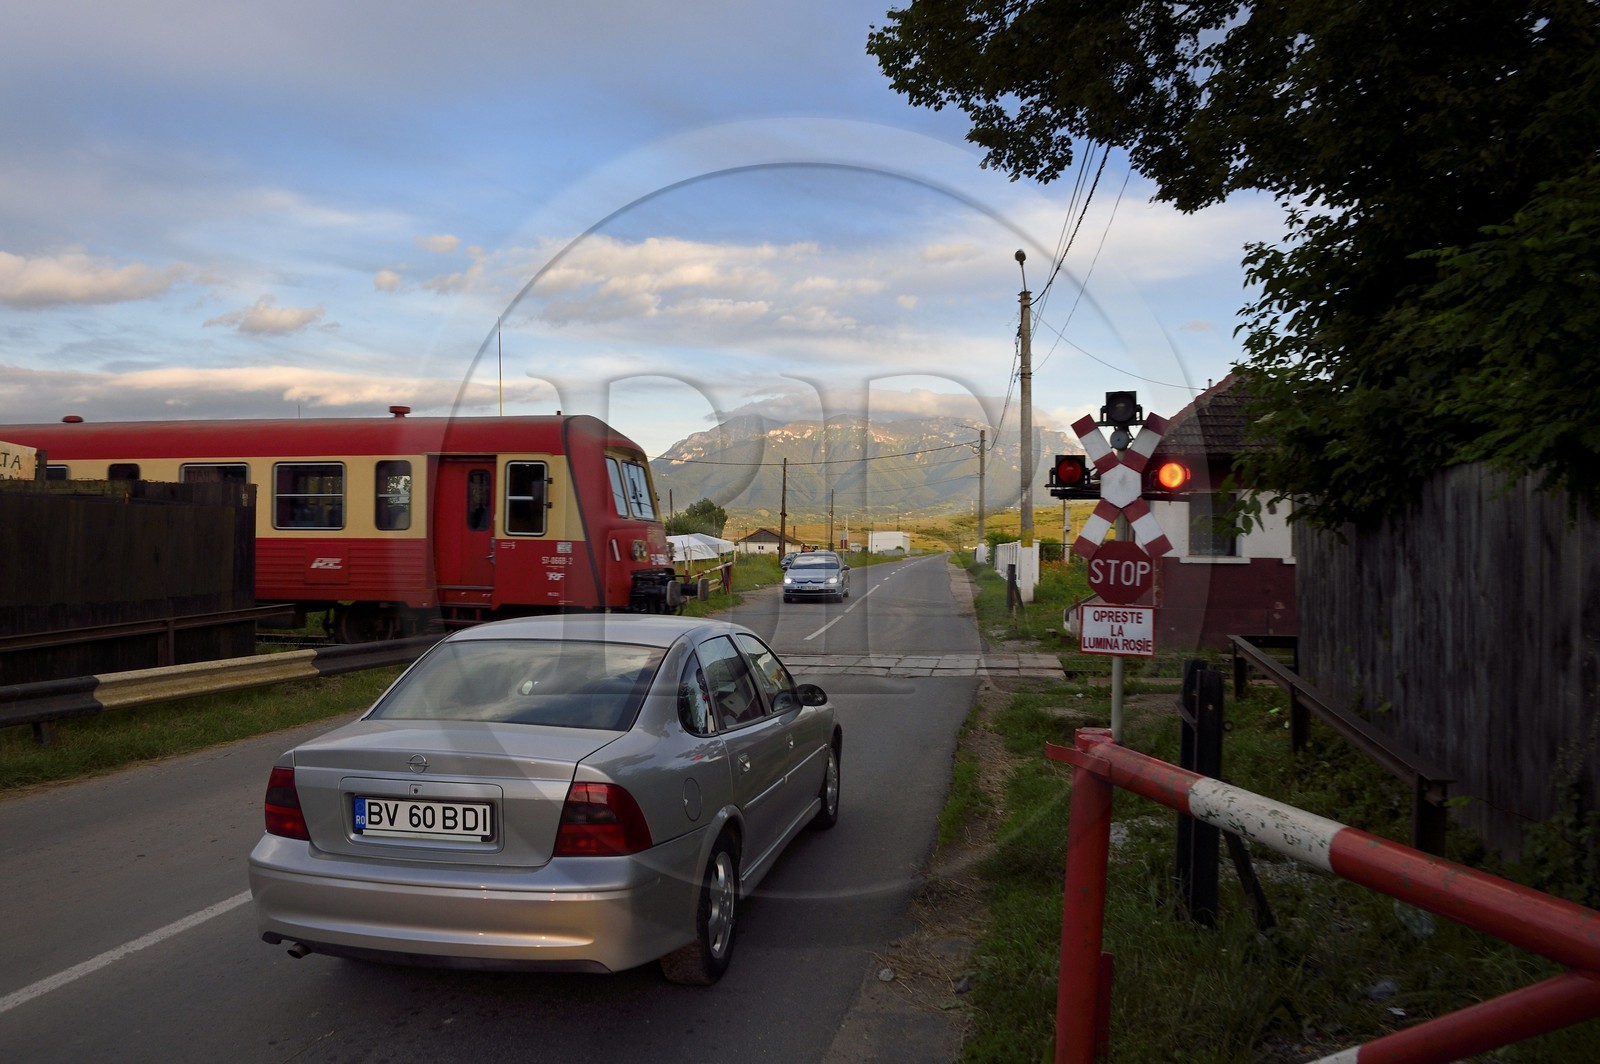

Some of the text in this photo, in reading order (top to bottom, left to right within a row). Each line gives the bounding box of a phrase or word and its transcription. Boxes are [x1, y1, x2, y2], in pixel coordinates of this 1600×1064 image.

[1090, 558, 1151, 587] STOP
[1110, 624, 1125, 638] LA
[1083, 637, 1120, 651] LUMINA
[355, 814, 366, 825] RO
[367, 802, 488, 832] BV 60 BDI
